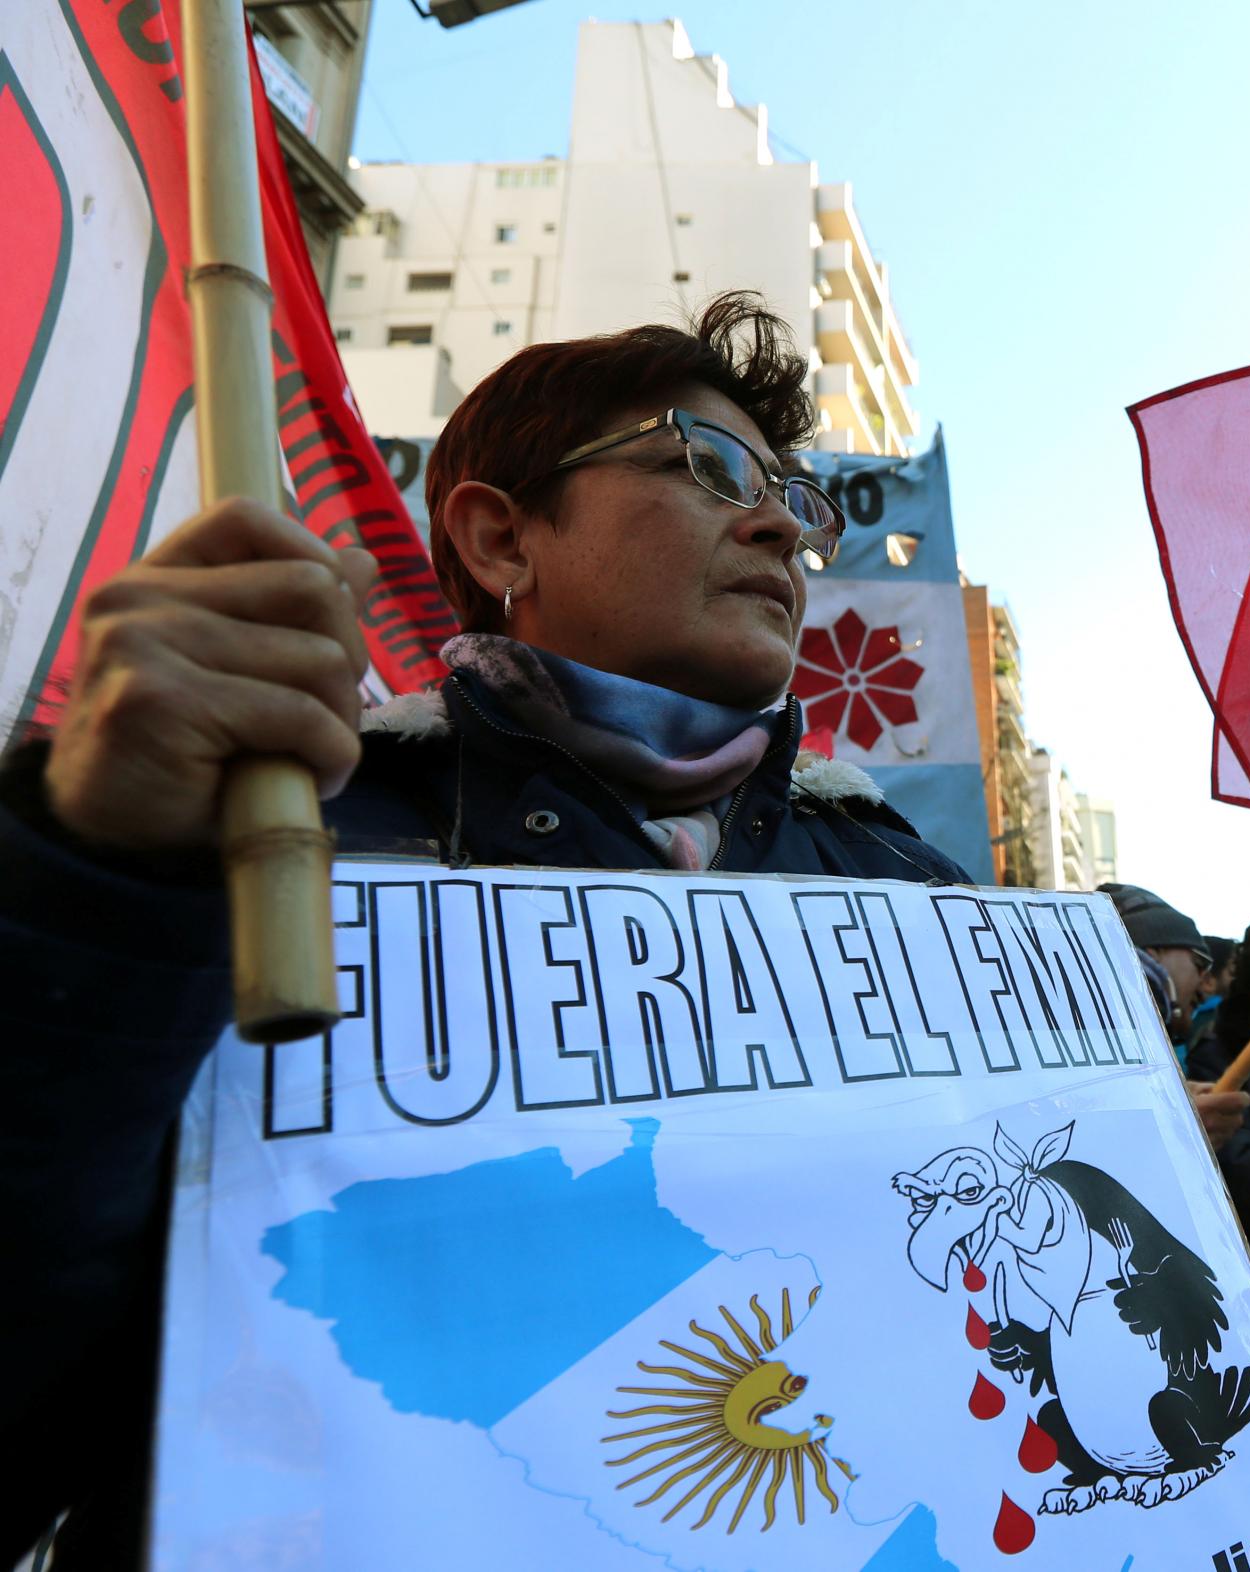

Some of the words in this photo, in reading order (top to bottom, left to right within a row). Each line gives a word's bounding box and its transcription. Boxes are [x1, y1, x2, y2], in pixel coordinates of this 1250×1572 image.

[263, 879, 813, 1140] FUERA
[792, 891, 962, 1083] EL
[935, 895, 1149, 1074] FMI
